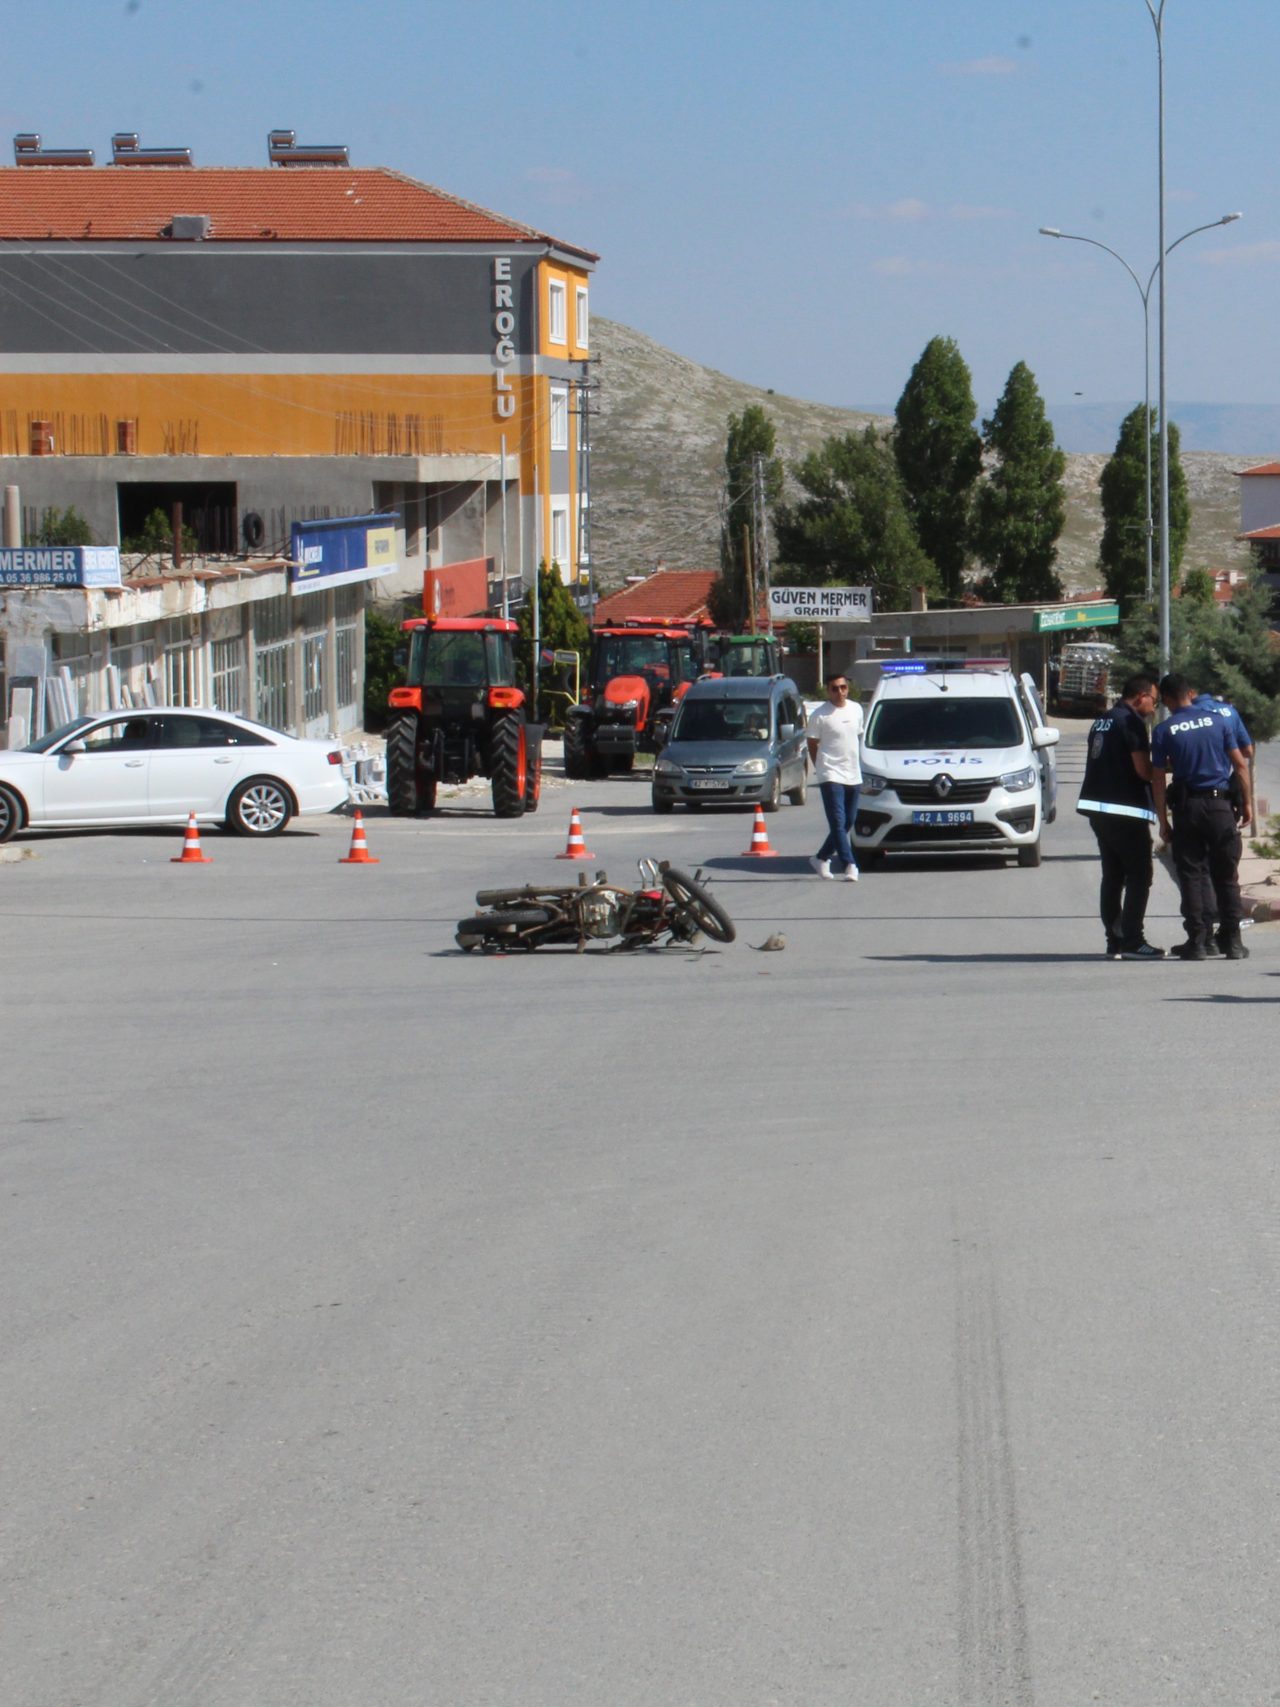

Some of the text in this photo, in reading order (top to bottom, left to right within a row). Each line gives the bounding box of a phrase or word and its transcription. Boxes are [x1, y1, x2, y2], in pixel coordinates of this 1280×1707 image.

[494, 257, 516, 418] EROĞLU
[0, 550, 77, 571] MERMER
[771, 588, 867, 607] GÜVEN MERMER
[793, 605, 841, 617] GRANİT
[1170, 717, 1213, 735] POLİS
[903, 756, 984, 766] POLİS
[919, 811, 972, 823] 42 A 9694
